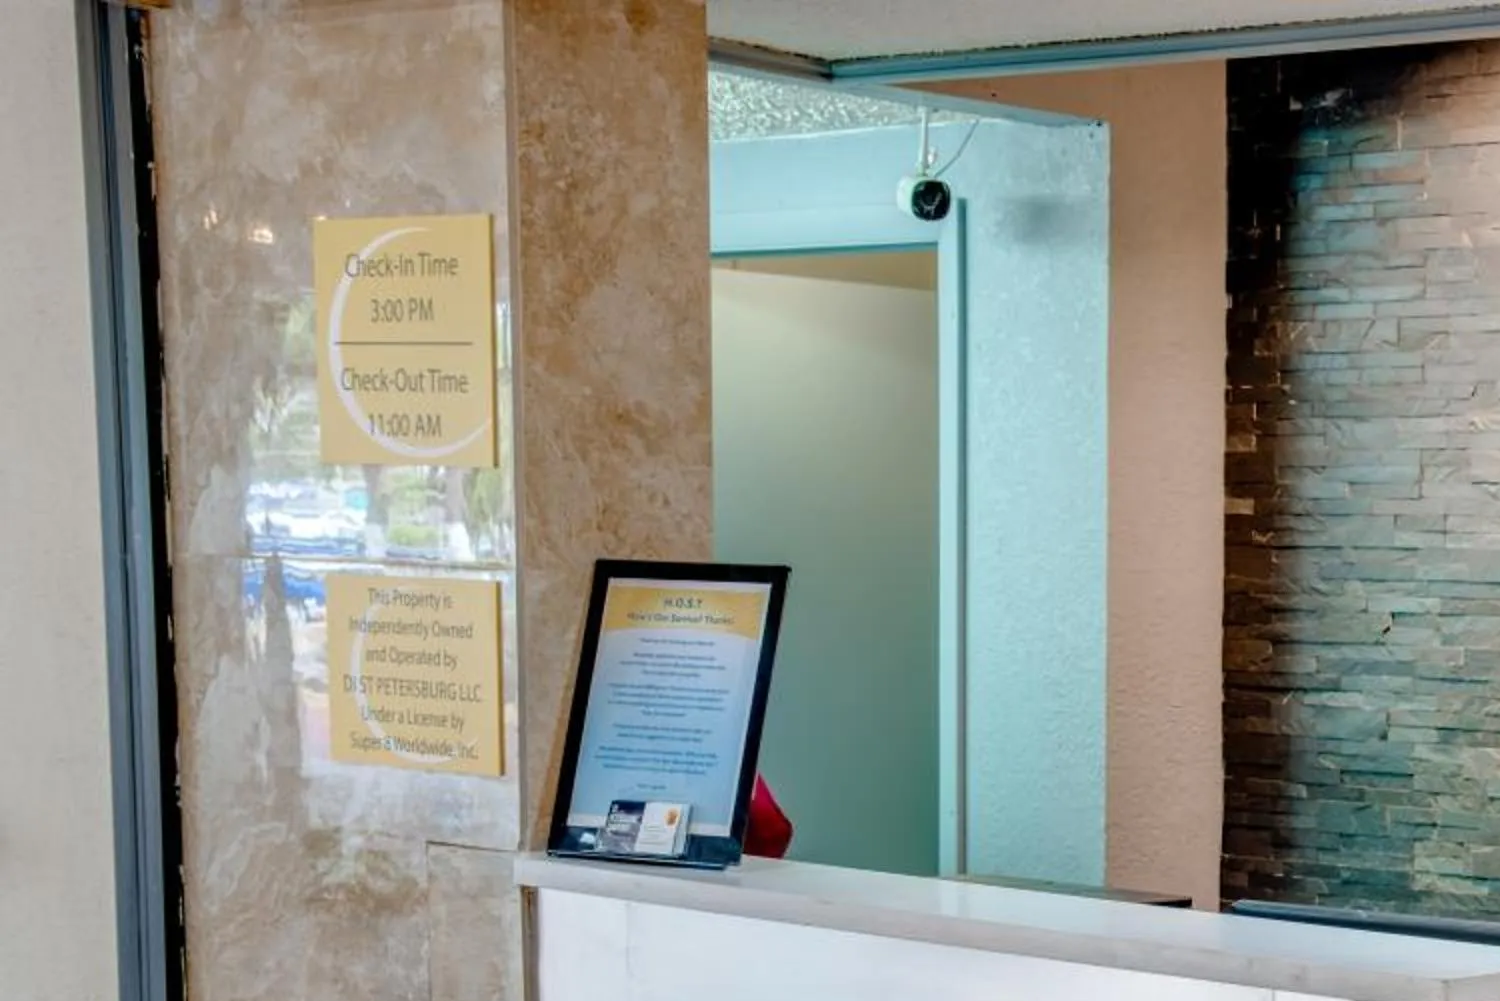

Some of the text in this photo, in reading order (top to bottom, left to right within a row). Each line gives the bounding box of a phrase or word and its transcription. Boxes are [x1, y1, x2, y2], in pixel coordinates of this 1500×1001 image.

[345, 252, 459, 277] Check-In Time
[371, 298, 434, 323] 3:00 PM
[341, 367, 470, 393] Check-Out Time
[368, 413, 442, 437] 11:00 AM
[368, 588, 390, 606] This
[393, 589, 440, 611] Property
[348, 615, 473, 640] Independently Owned
[366, 646, 457, 670] and Operated by
[361, 704, 395, 722] Under
[407, 709, 448, 727] License
[450, 712, 464, 733] by
